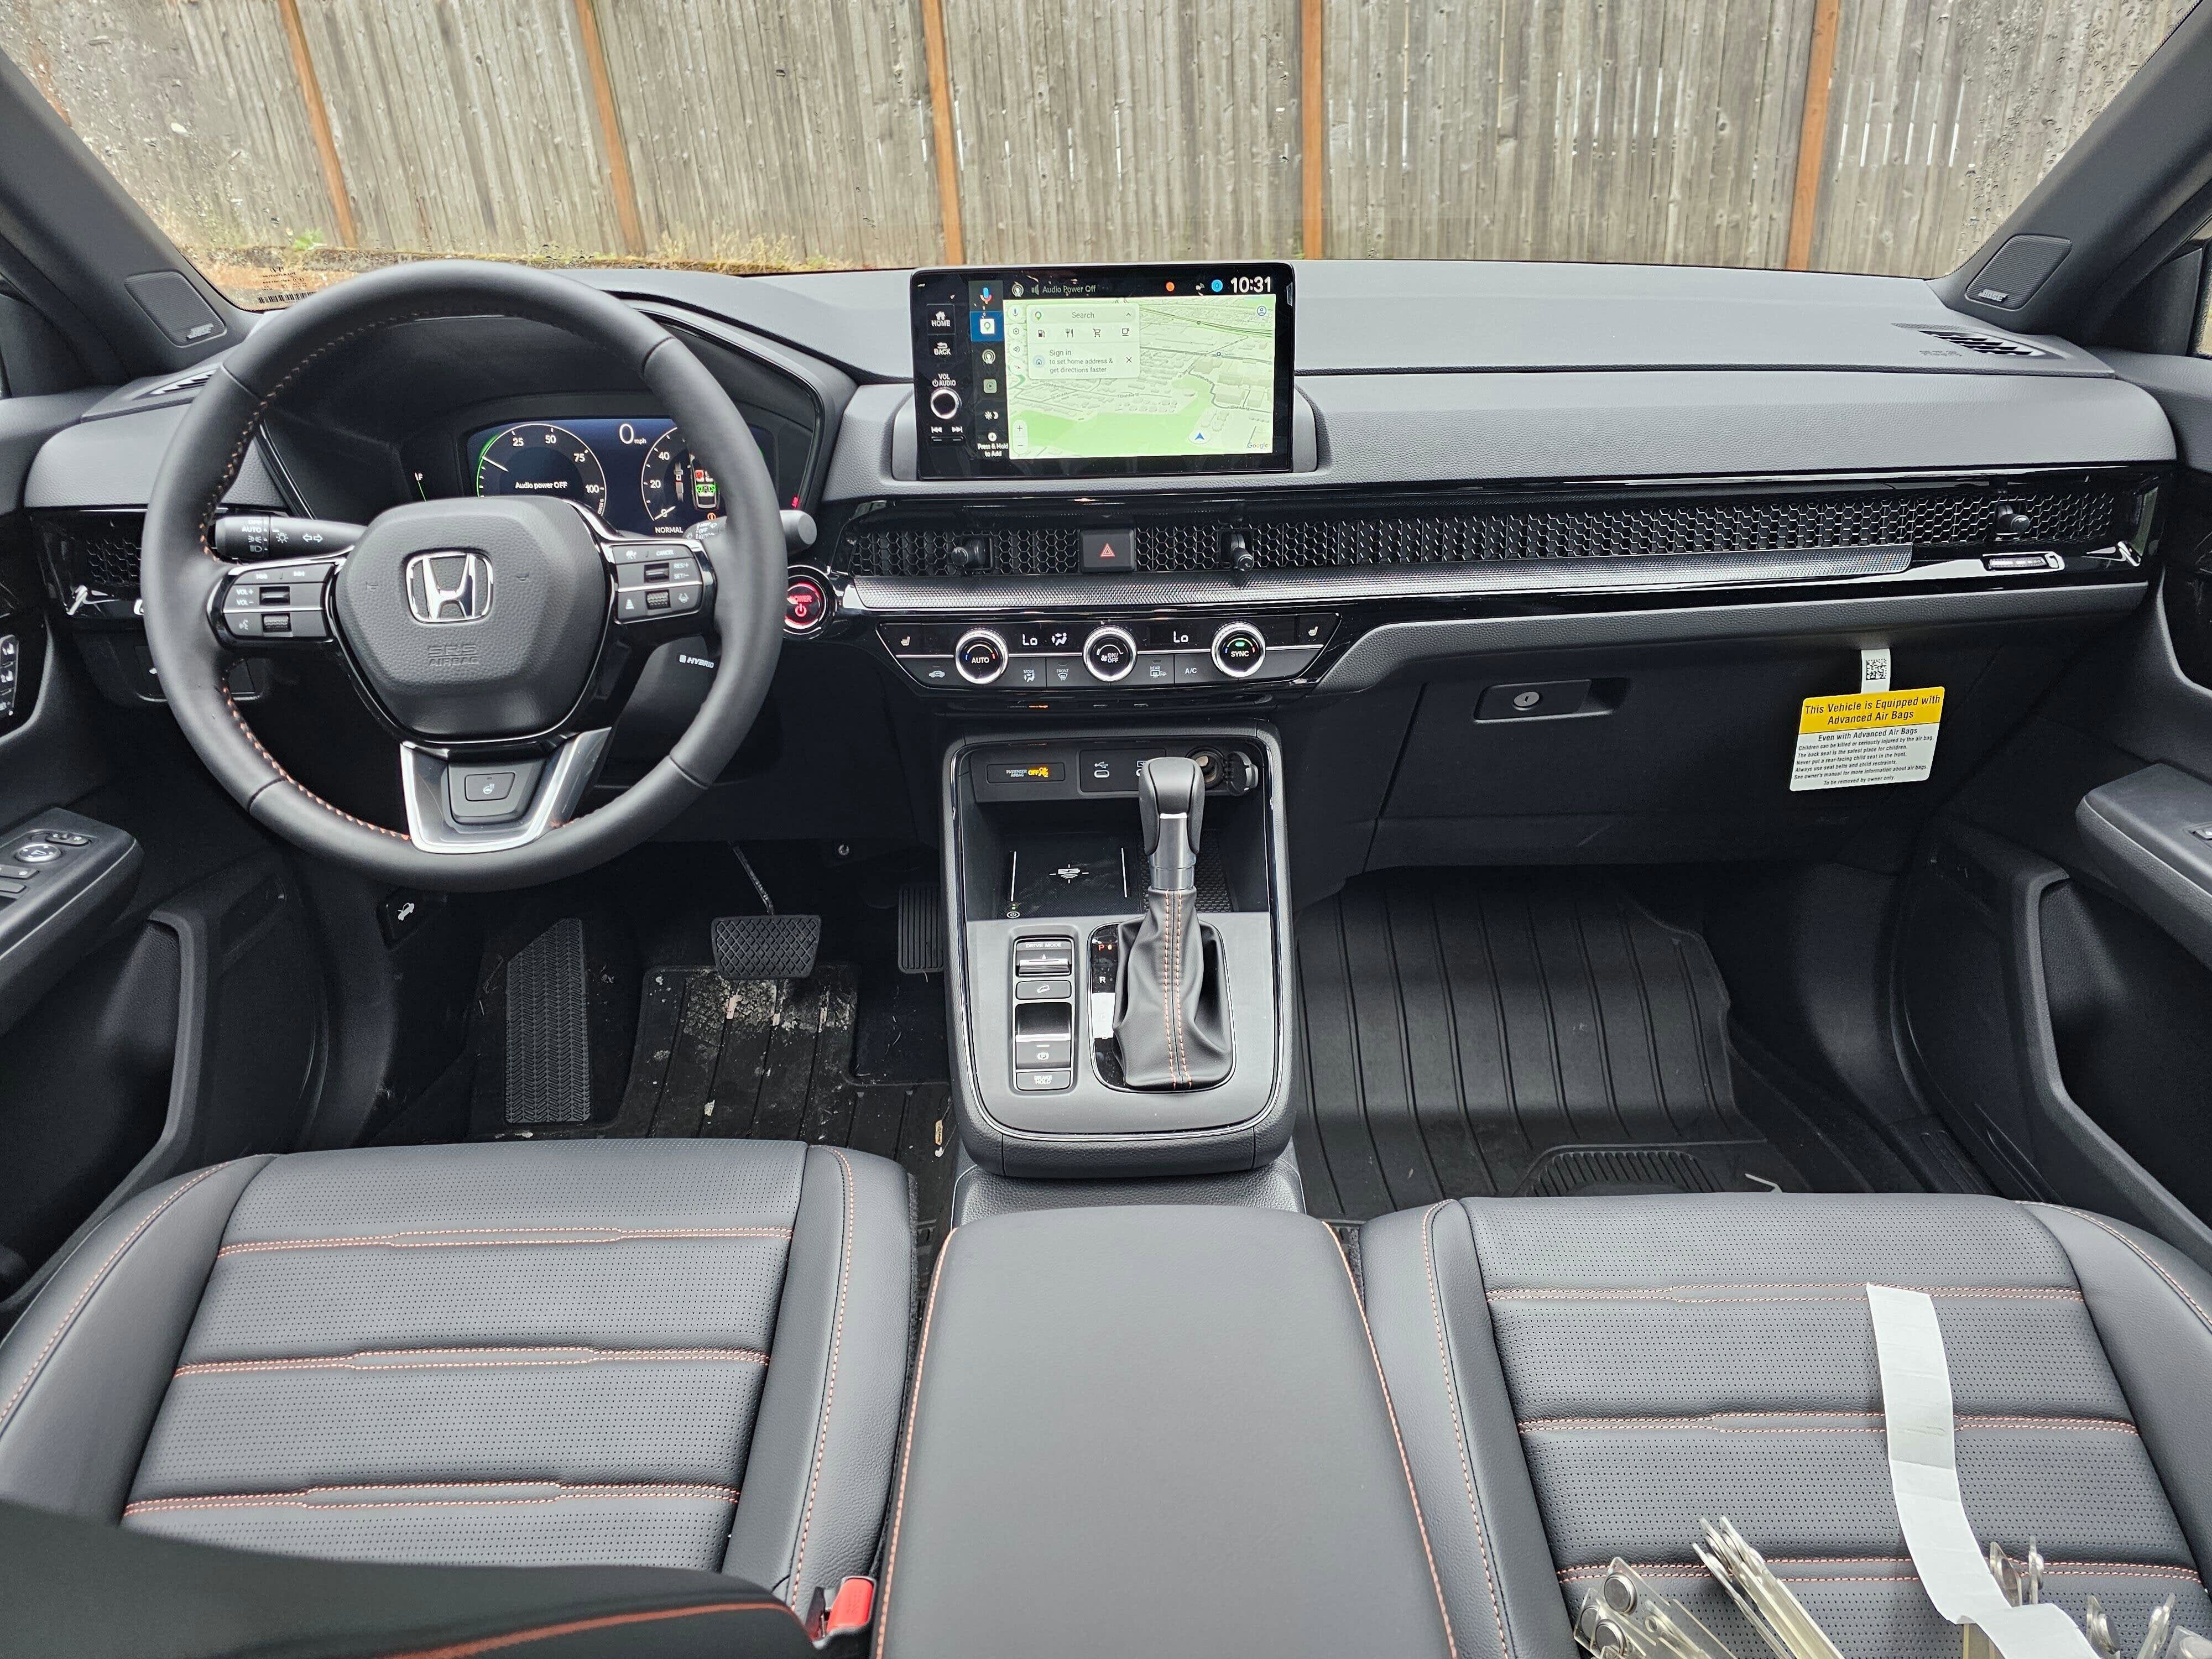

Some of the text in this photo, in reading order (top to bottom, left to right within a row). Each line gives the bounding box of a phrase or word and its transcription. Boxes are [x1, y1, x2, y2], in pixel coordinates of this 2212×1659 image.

[1063, 285, 1083, 293] Power
[1230, 276, 1271, 293] 10:31
[1980, 289, 2006, 302] BOSE
[1049, 349, 1064, 357] Sign
[545, 435, 556, 444] 50
[619, 423, 634, 445] 0
[513, 437, 524, 447] 25
[573, 453, 586, 462] 75
[658, 452, 670, 461] 40
[586, 484, 599, 493] 100
[650, 479, 661, 488] 20
[1022, 634, 1037, 646] Lo
[1173, 631, 1189, 643] Lo
[427, 644, 477, 656] SRS
[687, 657, 714, 669] HYBRID
[1806, 695, 1940, 714] This Vehicle is Equipped with
[1828, 711, 1914, 725] Advanced Air Bags
[1853, 730, 1887, 739] Advanced
